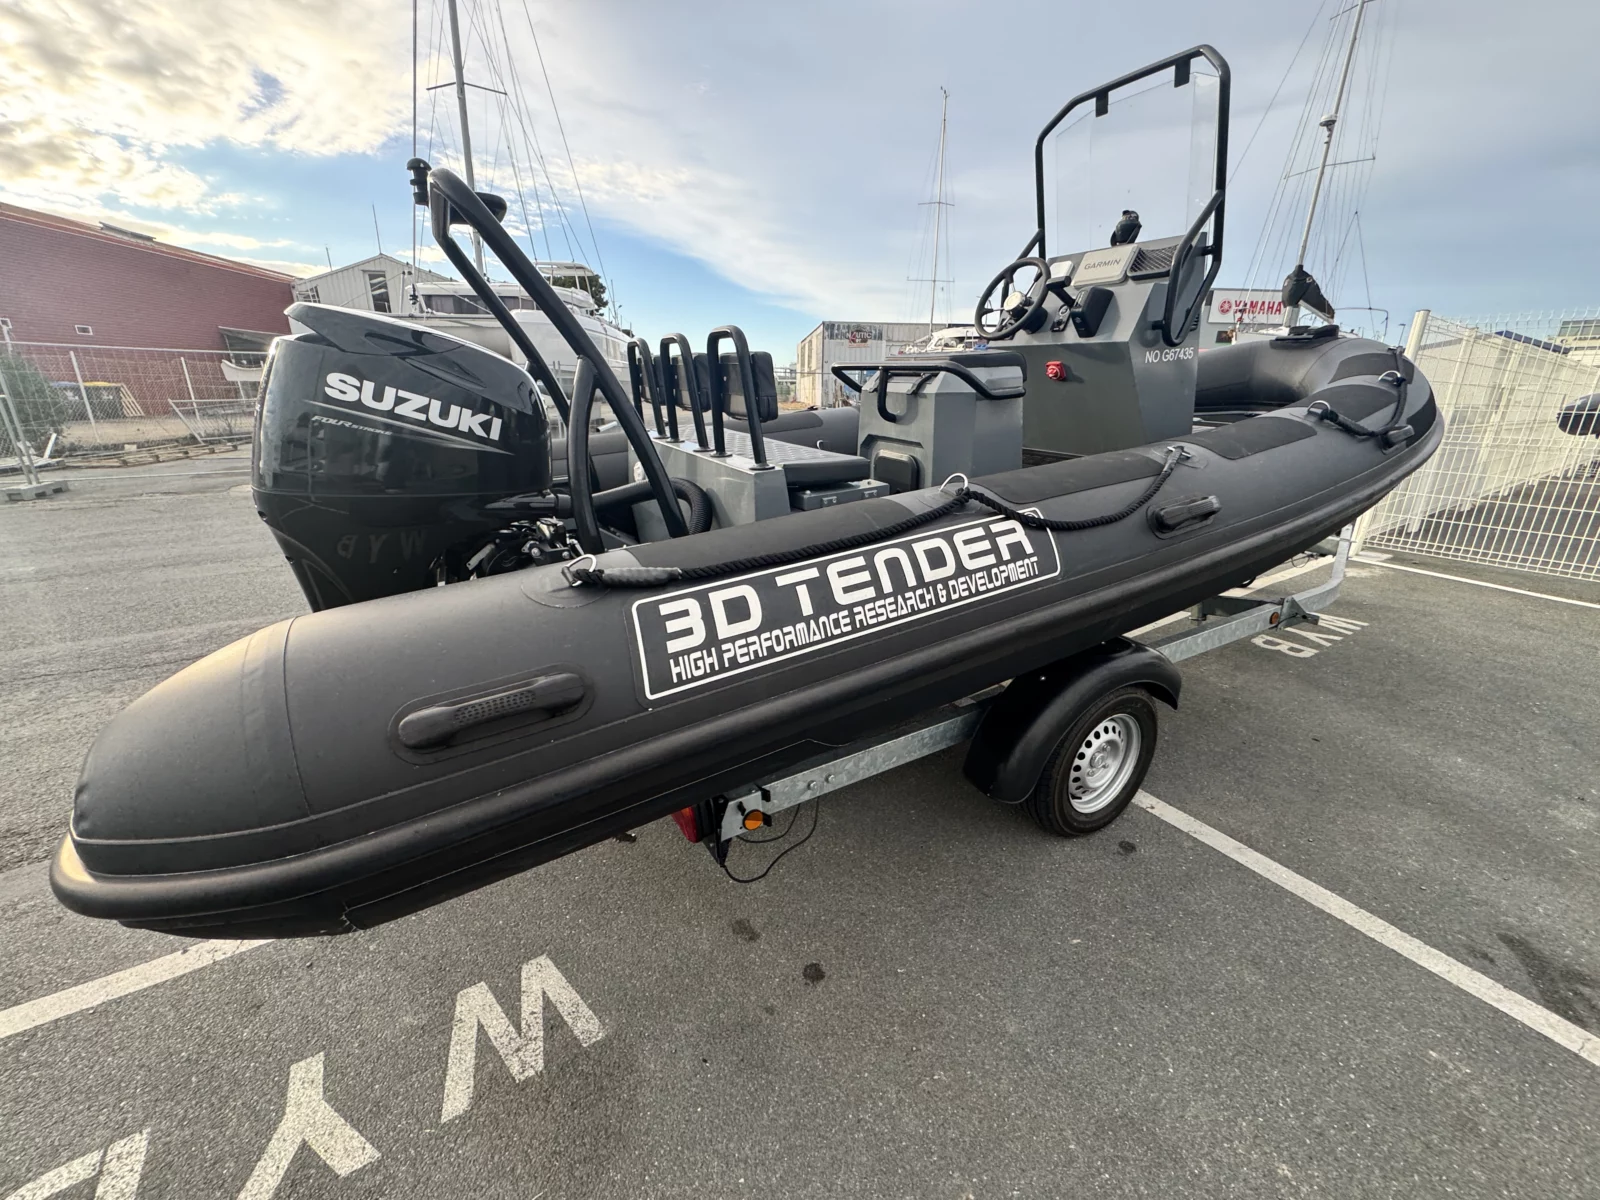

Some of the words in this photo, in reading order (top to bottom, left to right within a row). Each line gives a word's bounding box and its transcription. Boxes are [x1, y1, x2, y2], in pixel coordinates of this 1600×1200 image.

[1084, 258, 1122, 270] GARMIN
[1234, 300, 1284, 315] YAMAHA
[1145, 350, 1160, 363] NO
[1162, 347, 1194, 362] G67435
[324, 372, 503, 442] SUZUKI
[311, 415, 353, 428] FOUR
[658, 584, 763, 654] 3D
[776, 519, 1035, 617] TENDER
[669, 647, 719, 684] HIGH
[721, 609, 852, 668] PERFORMANCE
[853, 586, 936, 629] RESEARCH
[937, 583, 947, 603] &
[948, 556, 1039, 601] DEVELOPMENT
